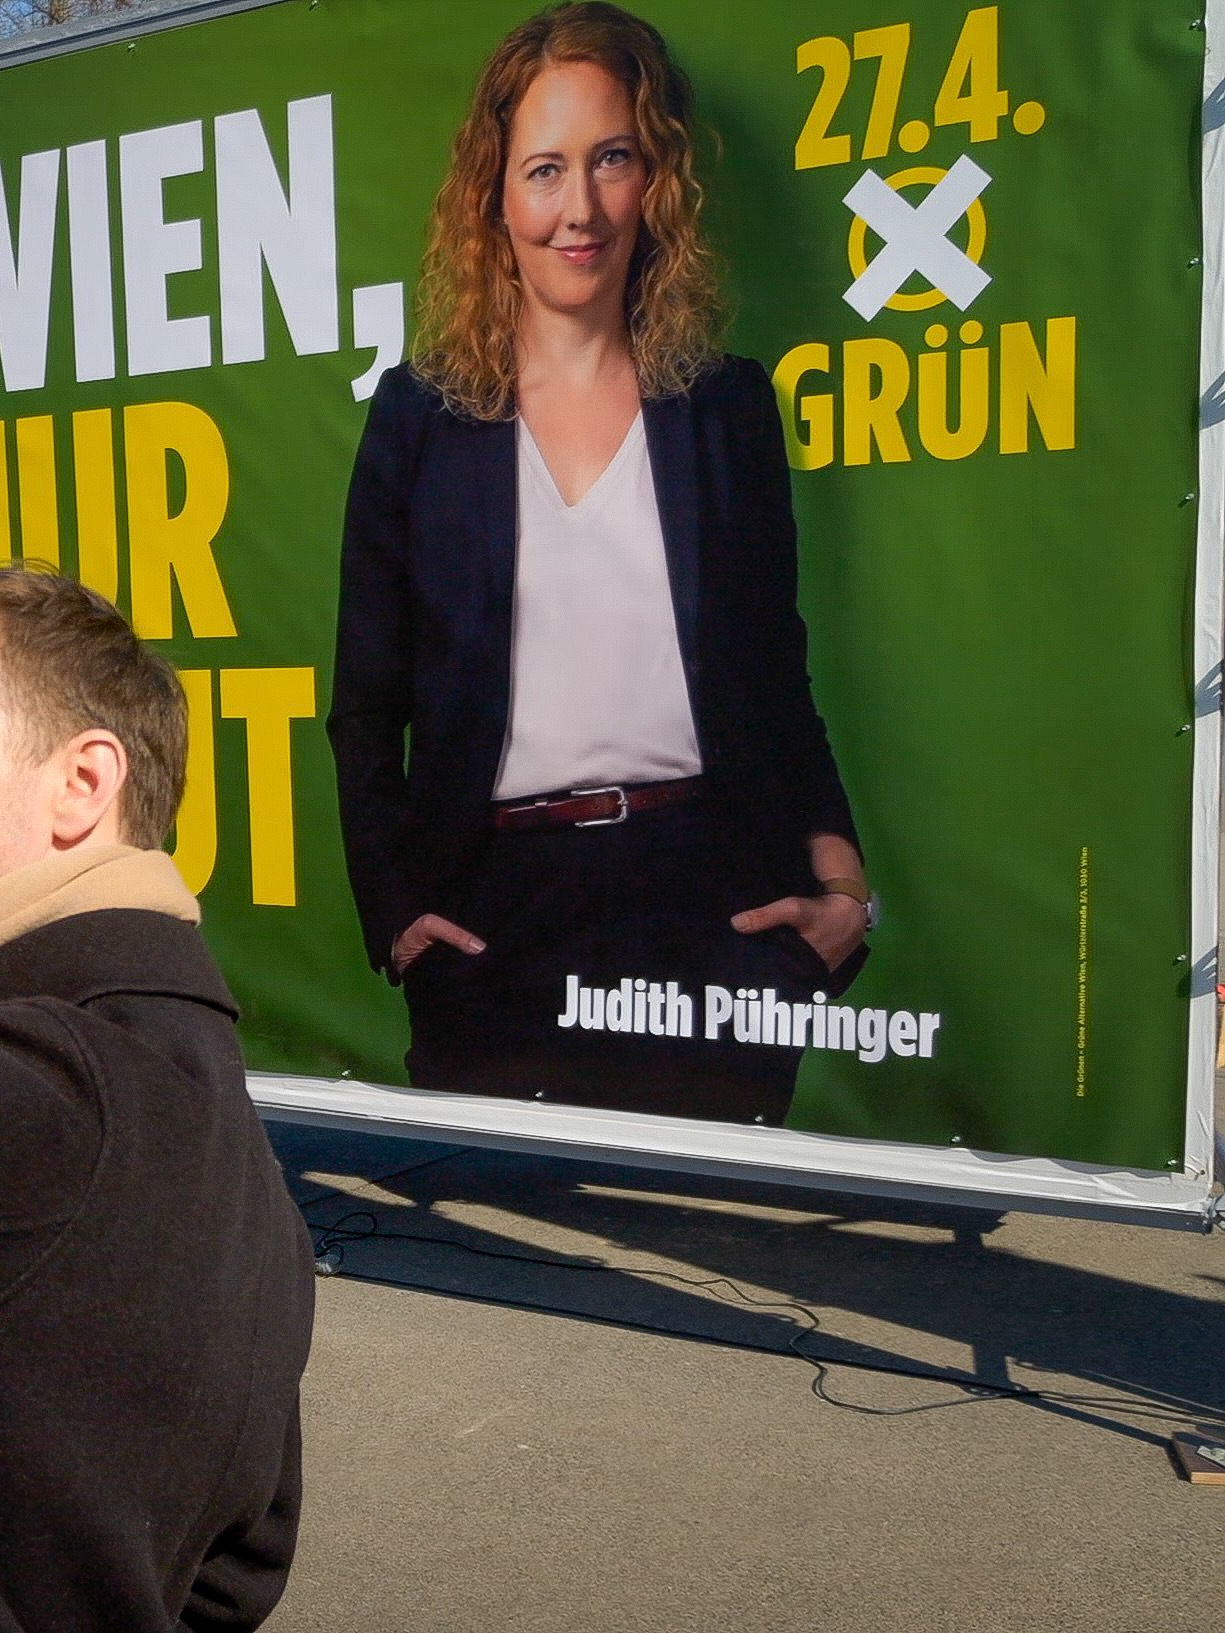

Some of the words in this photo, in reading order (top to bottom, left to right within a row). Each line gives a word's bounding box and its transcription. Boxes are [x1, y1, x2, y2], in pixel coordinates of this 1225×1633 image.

[794, 5, 1046, 171] 27.4.
[772, 316, 1077, 471] GRÜN
[557, 974, 693, 1038] Judith
[705, 985, 940, 1063] Pühringer
[1076, 1084, 1085, 1097] Die
